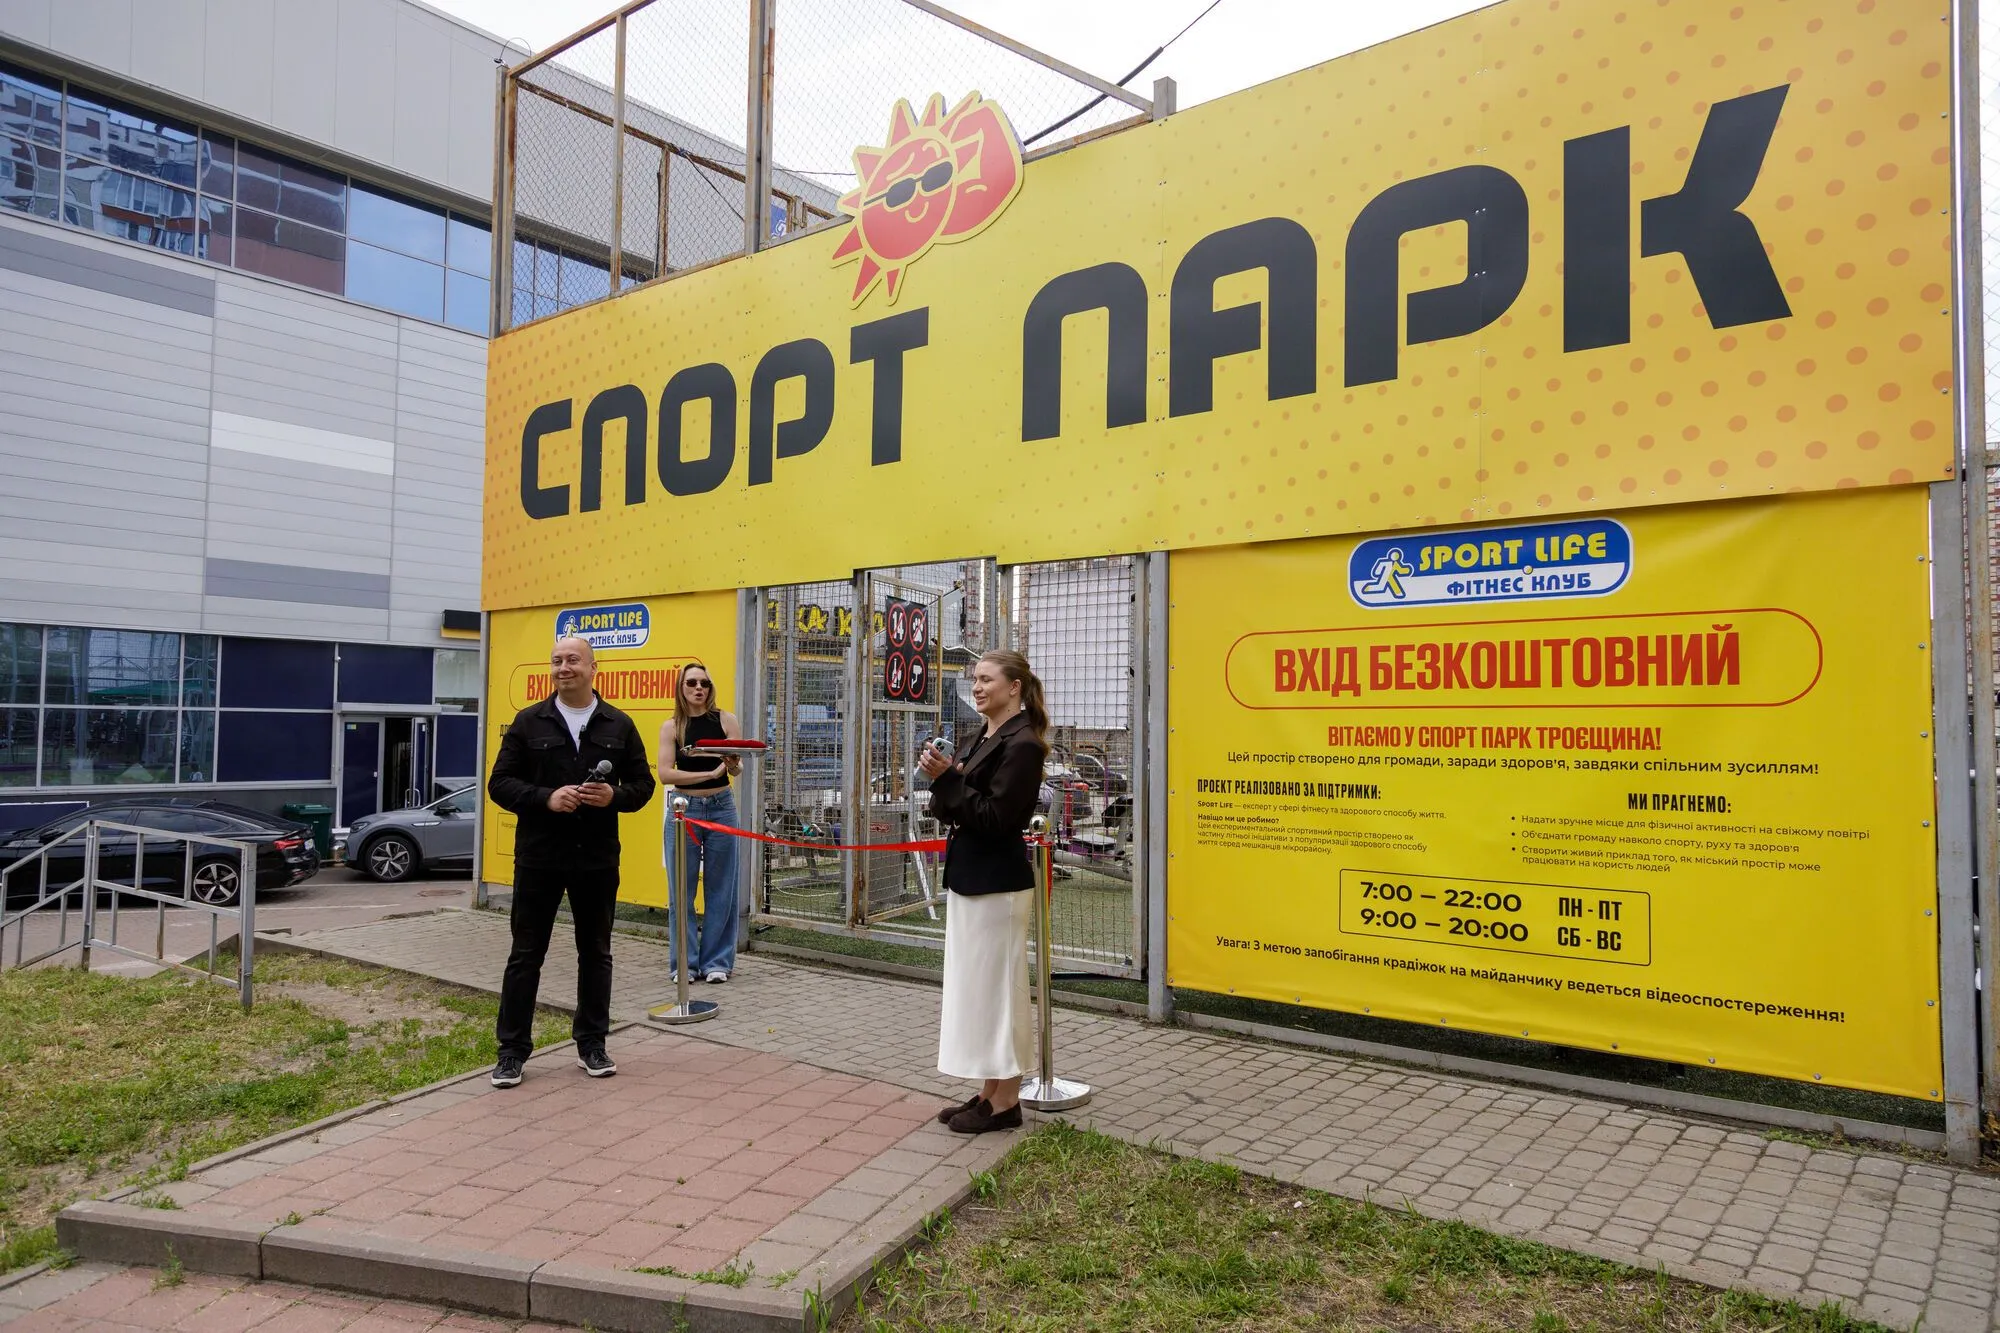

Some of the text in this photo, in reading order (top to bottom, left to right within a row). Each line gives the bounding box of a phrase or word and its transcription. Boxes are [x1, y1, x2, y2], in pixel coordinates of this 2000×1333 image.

[521, 84, 1793, 519] СПОРТ ПАРК
[1419, 532, 1606, 571] SPORT LIFE
[1447, 573, 1591, 596] ФІТНЕС КЛУБ
[580, 611, 642, 630] SPORT LIFE
[589, 634, 637, 645] ФІТНЕС КЛУБ
[1274, 624, 1740, 697] ВХІД БЕЗКОШТОВНИЙ
[1328, 726, 1661, 752] ВІТАЄМО У СПОРТ ПАРК ТРОЄЩИНА!
[1228, 752, 1819, 776] Цей простір створено для громади, заради здоров'я, завдяки спільним зусиллям!
[1198, 779, 1381, 799] ПРОЕКТ РЕАЛІЗОВАНО ЗА ПІДТРИМКИ:
[1279, 804, 1299, 812] сфері
[1301, 805, 1329, 814] фітнесу
[1384, 809, 1417, 818] способу
[1628, 793, 1731, 813] МИ ПРАГНЕМО:
[1198, 822, 1211, 830] Цей
[1212, 823, 1285, 833] експериментальний
[1287, 827, 1332, 836] спортивний
[1334, 830, 1362, 838] простір
[1364, 832, 1402, 840] створено
[1247, 816, 1279, 824] робимо?
[1522, 815, 1556, 824] Надати
[1558, 818, 1593, 826] зручне
[1596, 818, 1624, 828] місце
[1648, 820, 1693, 830] фізичної
[1696, 823, 1756, 833] активності
[1776, 826, 1824, 838] свіжому
[1827, 829, 1870, 841] повітрі
[1198, 831, 1224, 839] частину
[1252, 834, 1288, 842] ініціативи
[1296, 837, 1348, 846] популяризації
[1393, 843, 1427, 852] способу
[1242, 842, 1281, 850] мешканців
[1283, 845, 1332, 854] мікрорайону.
[1574, 834, 1616, 843] громаду
[1619, 837, 1662, 845] навколо
[1665, 838, 1704, 849] спорту,
[1706, 840, 1731, 850] руху
[1522, 845, 1568, 857] Створити
[1570, 848, 1603, 858] живий
[1606, 851, 1650, 861] приклад
[1653, 854, 1678, 863] того,
[1695, 855, 1739, 866] міський
[1742, 859, 1785, 870] простір
[1789, 862, 1821, 871] може
[1522, 857, 1576, 866] працювати
[1593, 861, 1633, 871] користь
[1636, 862, 1670, 872] людей
[1360, 881, 1412, 902] 7:00
[1444, 888, 1522, 912] 22:00
[1559, 897, 1582, 918] ПН
[1599, 900, 1622, 920] ПТ
[1360, 908, 1417, 929] 9:00
[1449, 916, 1528, 942] 20:00
[1558, 926, 1580, 947] СБ
[1597, 930, 1621, 951] ВС
[1216, 936, 1250, 949] Увага!
[1264, 944, 1301, 955] метою
[1305, 948, 1380, 965] запобігання
[1383, 956, 1447, 974] крадіжок
[1450, 965, 1466, 976] на
[1471, 968, 1562, 991] майданчику
[1568, 979, 1641, 998] ведеться
[1646, 987, 1845, 1023] відеоспостереження!
